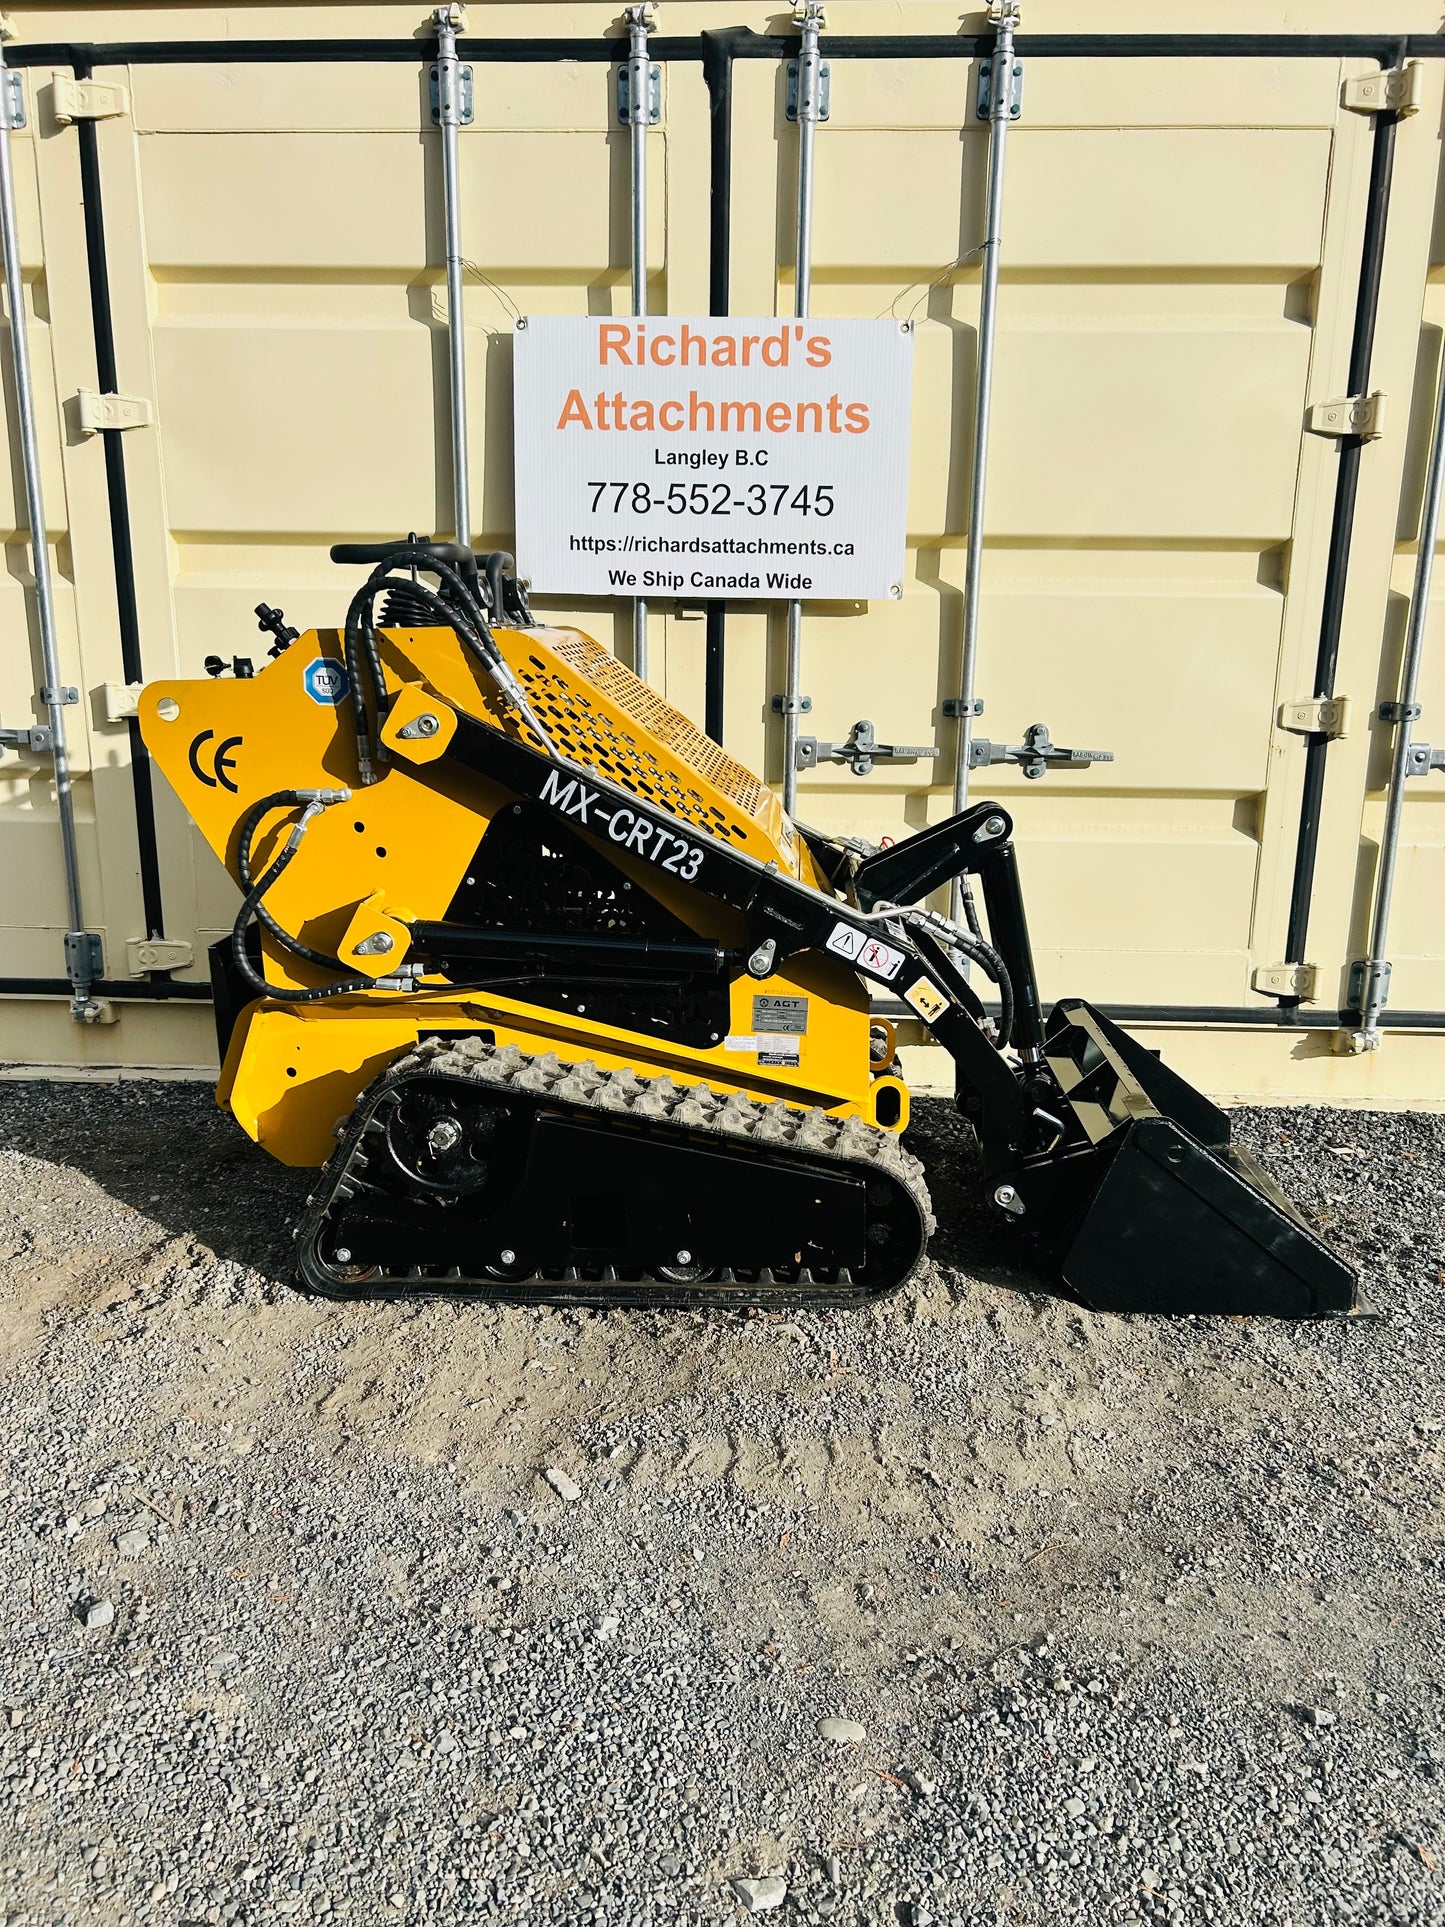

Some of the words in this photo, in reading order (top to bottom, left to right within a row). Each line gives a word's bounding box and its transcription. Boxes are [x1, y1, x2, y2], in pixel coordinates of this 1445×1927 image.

[599, 323, 833, 368] Richard's
[556, 388, 871, 435] Attachments
[654, 448, 730, 470] Langley
[734, 449, 769, 467] B.C
[587, 481, 834, 517] 778-552-3745
[569, 534, 855, 557] https://richardsattachments.ca
[608, 569, 637, 587] We
[642, 570, 684, 590] Ship
[690, 571, 761, 589] Canada
[765, 572, 813, 590] Wide
[188, 729, 243, 794] CE
[538, 768, 705, 880] MX-CRT23
[773, 1000, 800, 1008] AGT
